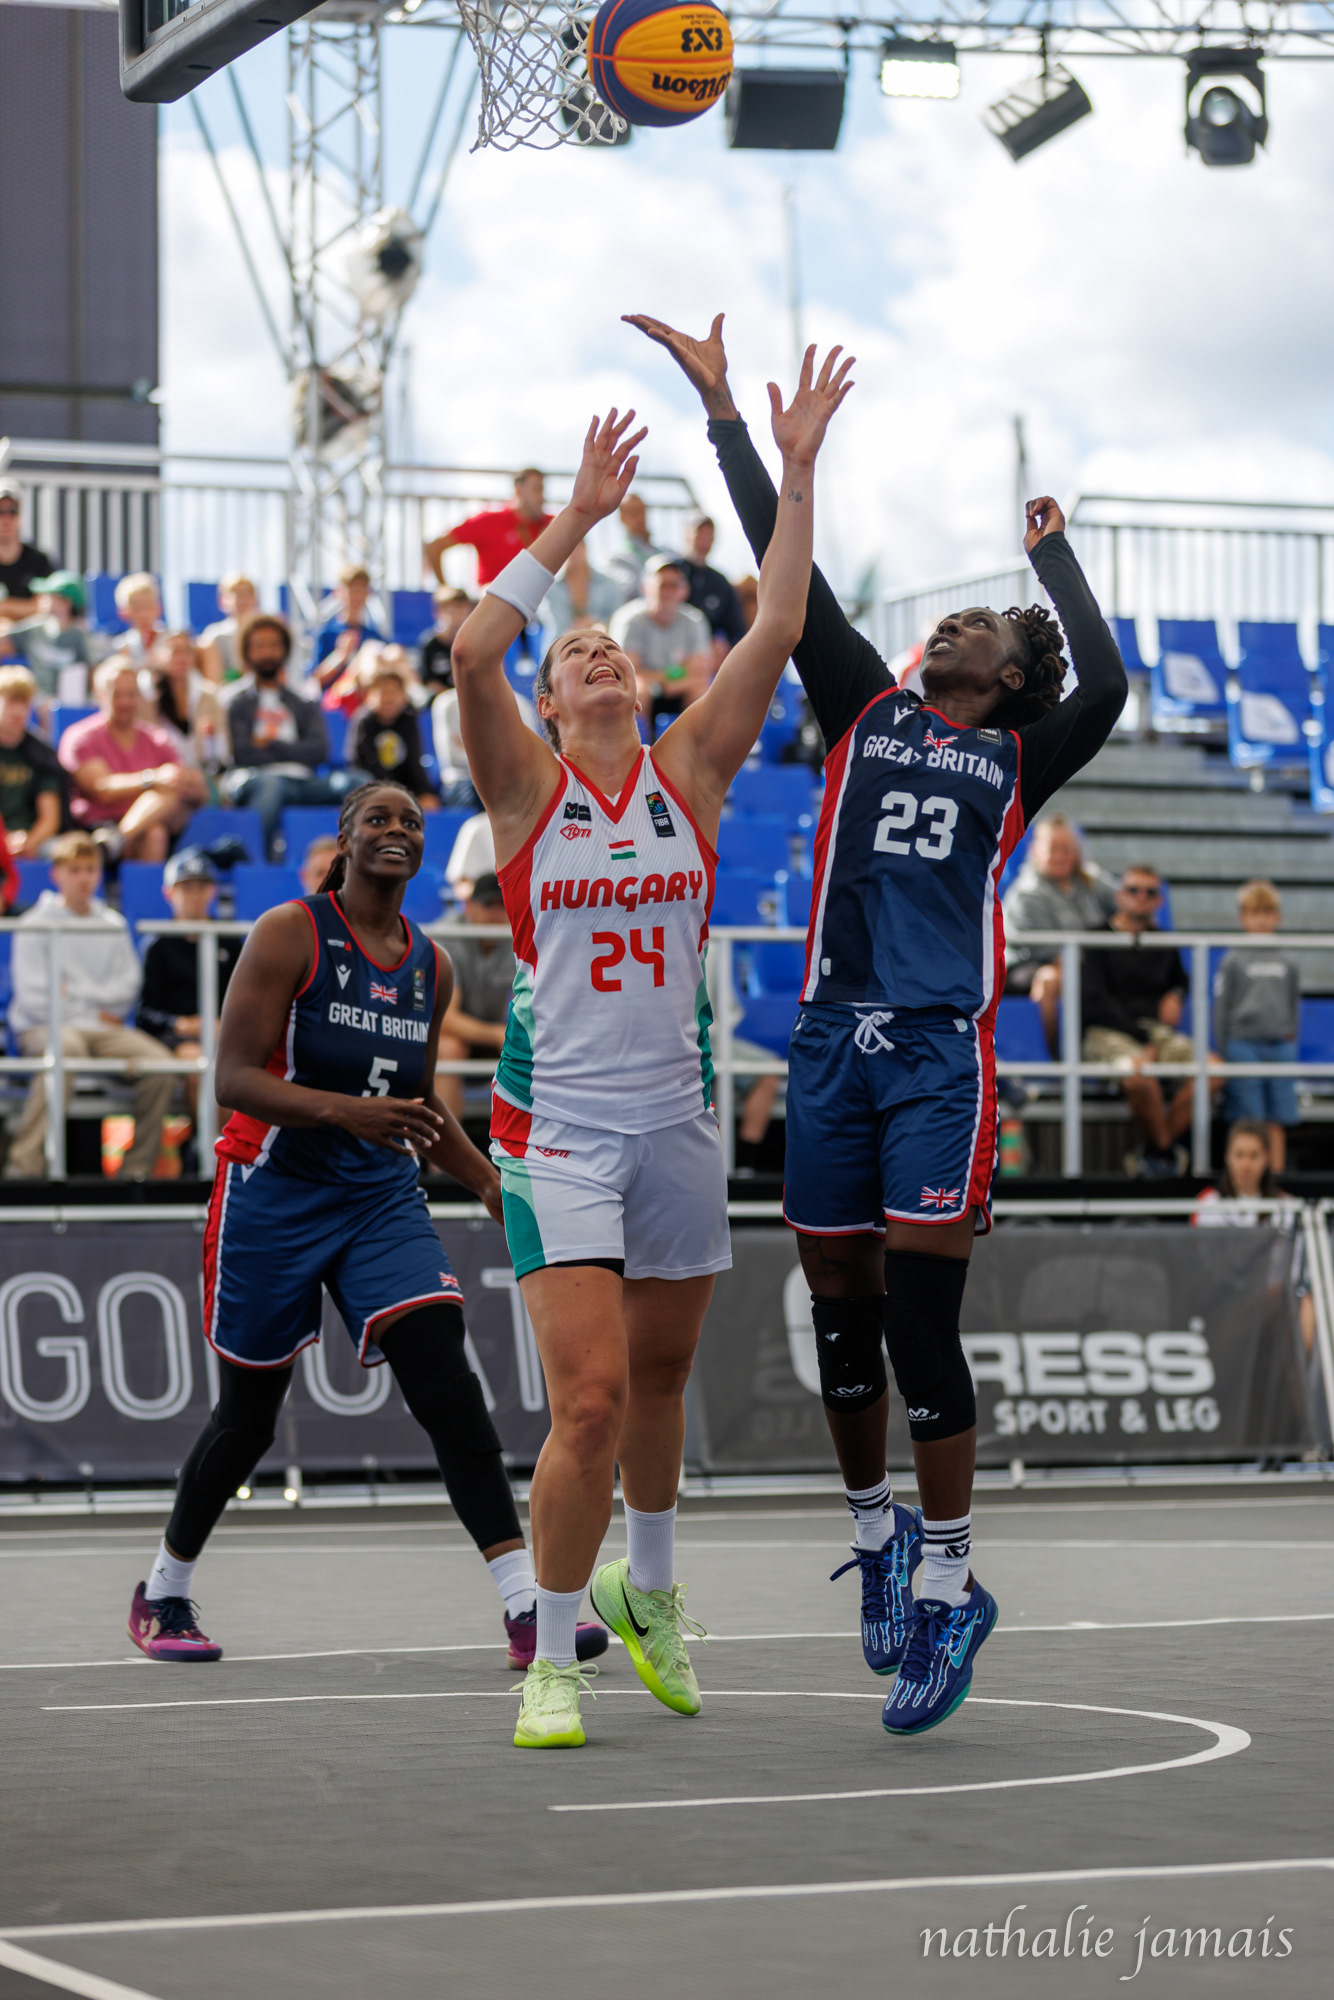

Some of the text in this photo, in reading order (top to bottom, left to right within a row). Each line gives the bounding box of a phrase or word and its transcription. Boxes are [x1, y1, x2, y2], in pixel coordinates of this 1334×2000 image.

[652, 71, 731, 101] Wilson
[926, 748, 1004, 791] BRITAIN
[873, 790, 960, 861] 23
[540, 870, 703, 912] HUNGARY
[590, 926, 665, 993] 24
[328, 1002, 430, 1043] GREAT BRITAIN
[361, 1056, 399, 1098] 5
[992, 1397, 1221, 1436] SPORT & LEG
